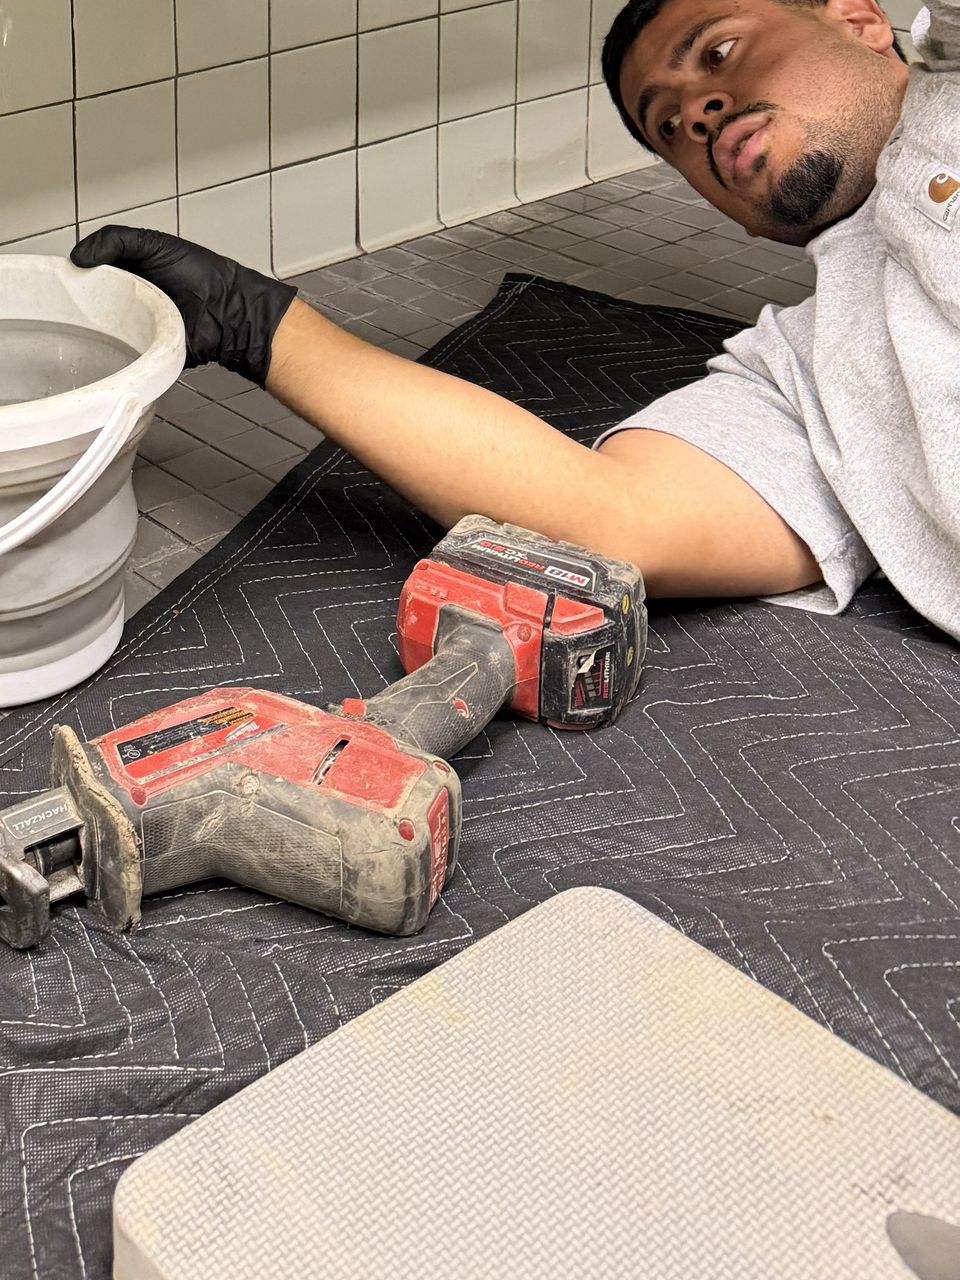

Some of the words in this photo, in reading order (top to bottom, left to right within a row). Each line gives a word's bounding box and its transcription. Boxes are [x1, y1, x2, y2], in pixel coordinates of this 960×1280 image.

[548, 567, 587, 585] M18
[602, 650, 611, 700] REDLITHIUM
[12, 803, 70, 831] HACKZALL
